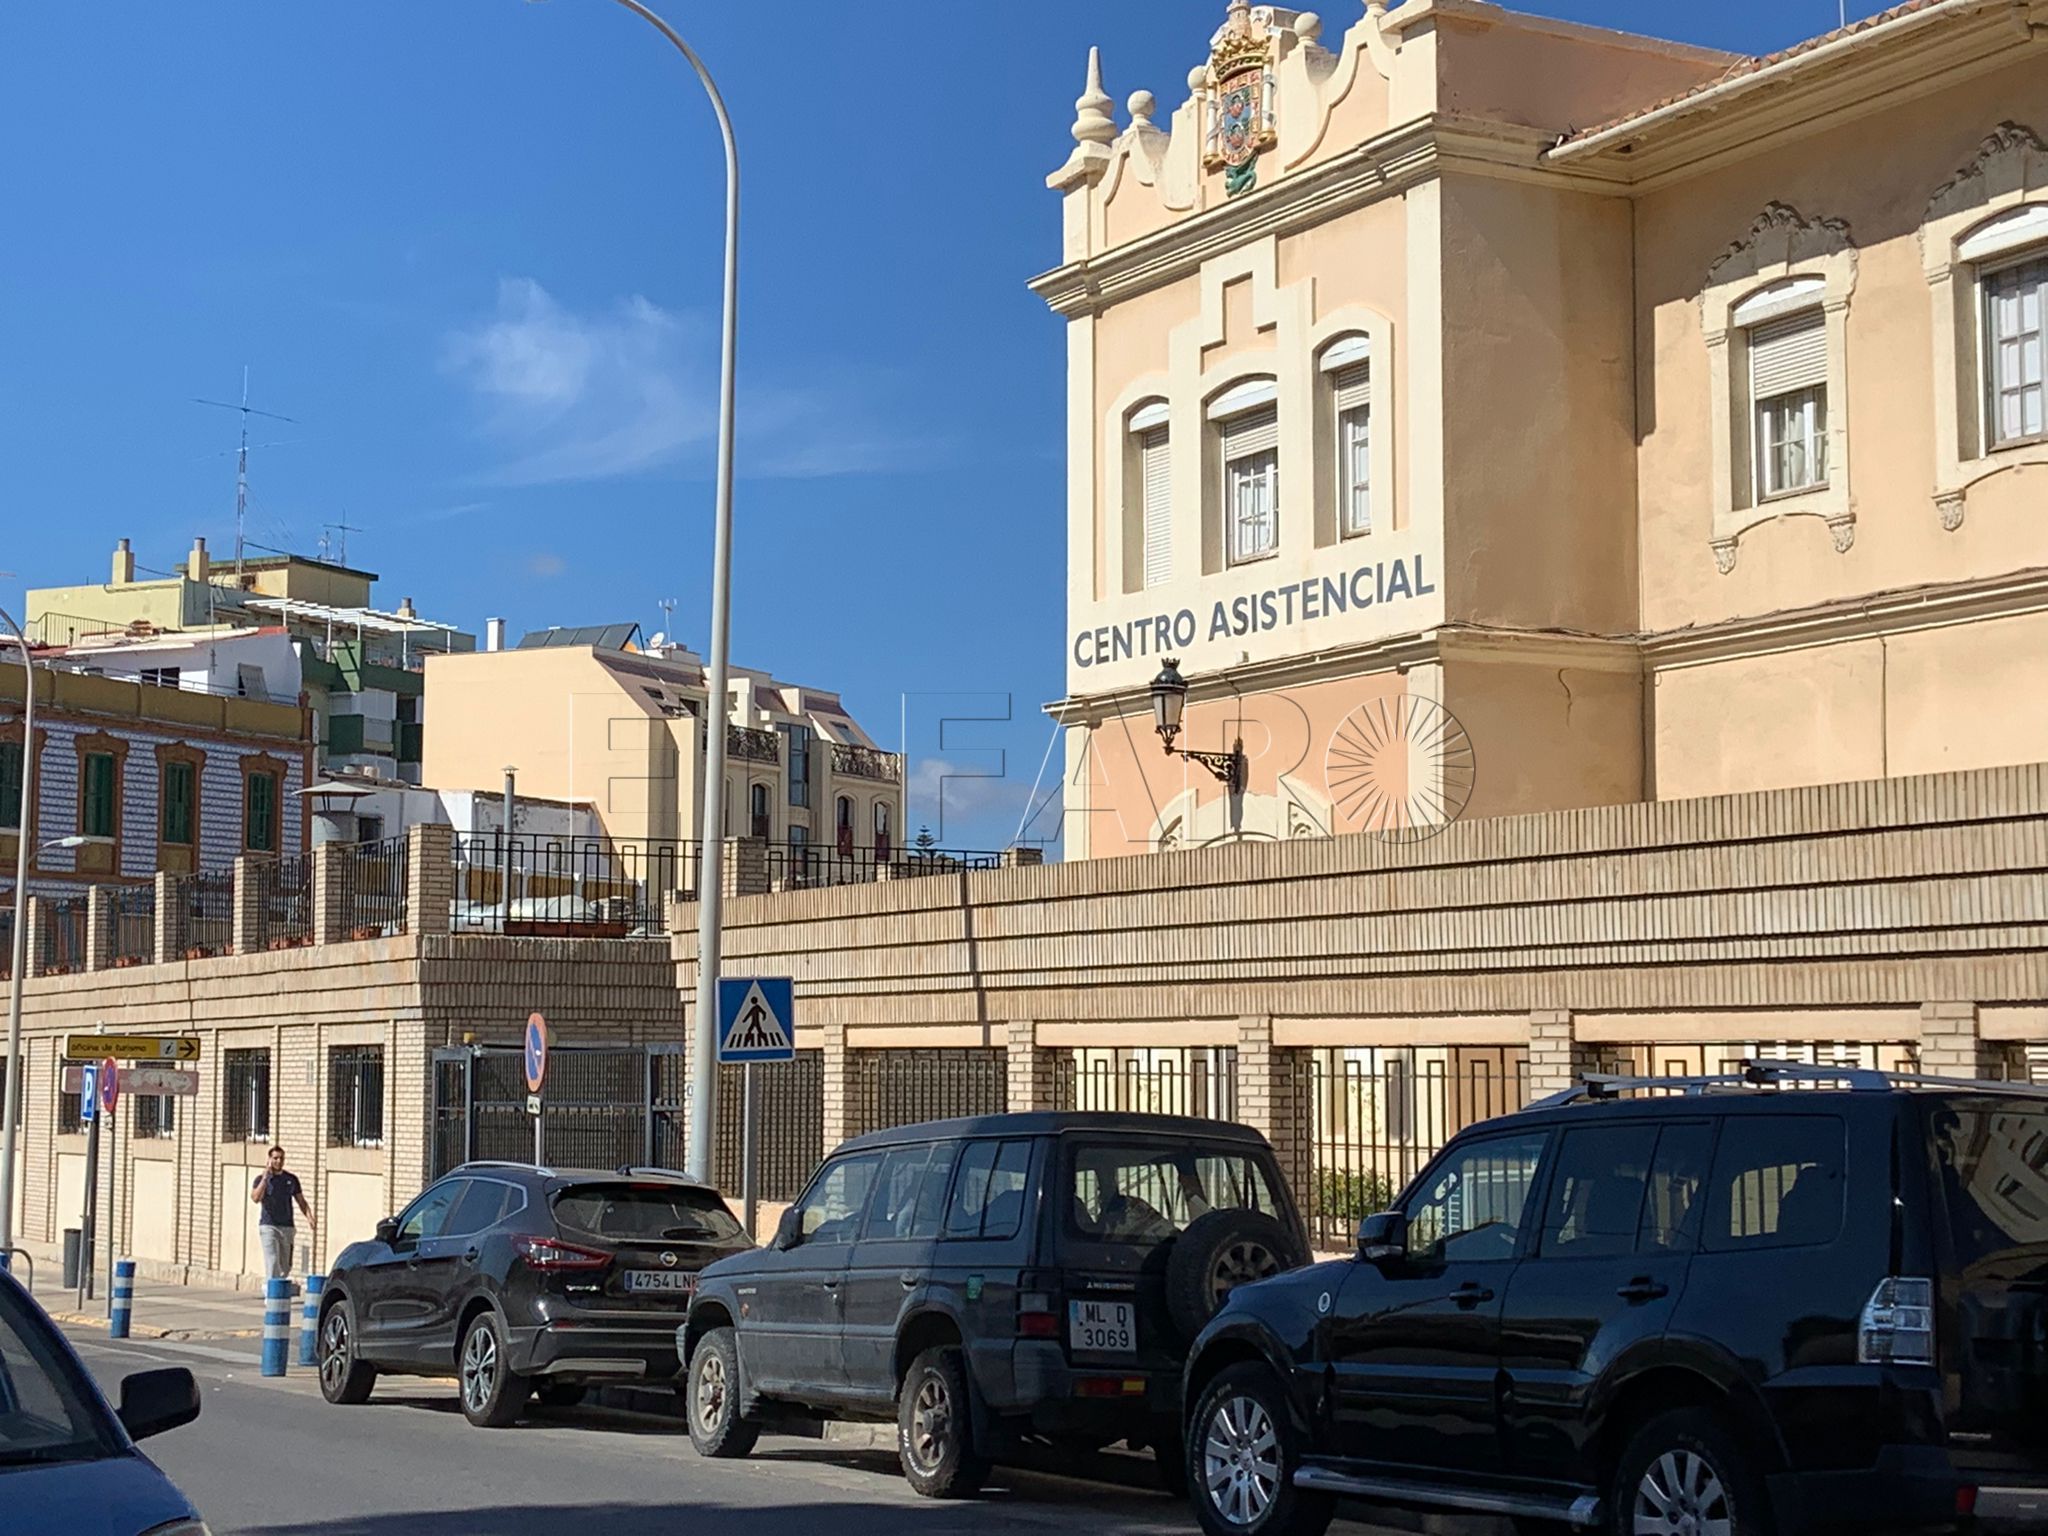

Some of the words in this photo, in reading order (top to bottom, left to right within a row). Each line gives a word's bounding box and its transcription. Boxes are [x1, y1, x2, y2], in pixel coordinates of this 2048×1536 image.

[1074, 608, 1196, 668] CENTRO
[1208, 554, 1435, 642] ASISTENCIAL
[634, 1273, 669, 1289] 4754
[1085, 1304, 1106, 1323] ML
[1084, 1328, 1129, 1348] 3069
